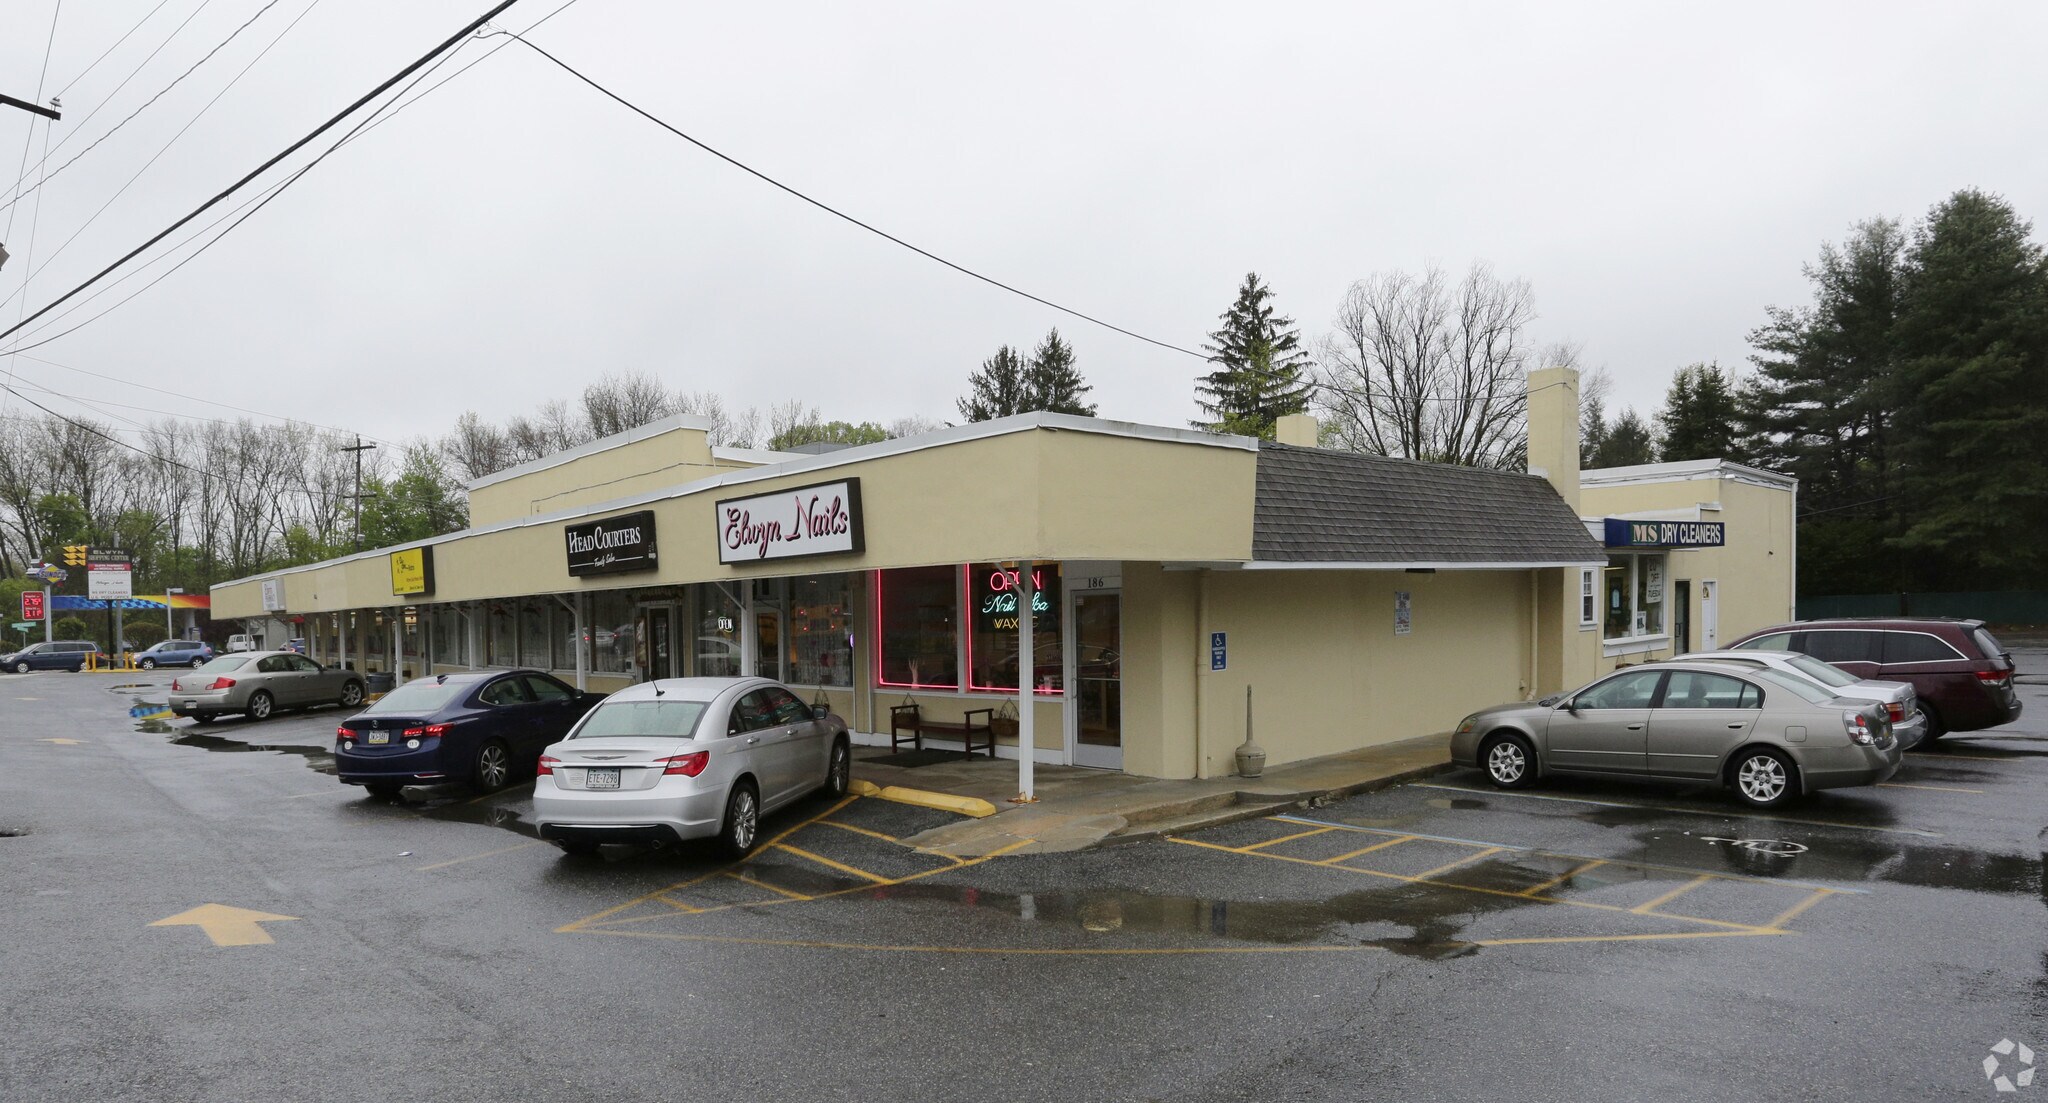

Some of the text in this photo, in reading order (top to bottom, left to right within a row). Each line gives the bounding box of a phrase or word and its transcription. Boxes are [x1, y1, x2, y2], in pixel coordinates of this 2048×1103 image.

[724, 494, 849, 559] Elwyn Nails
[1632, 523, 1721, 544] MS DRY CLEANERS
[568, 526, 641, 554] HEAD COURTERS
[1088, 577, 1104, 588] 186
